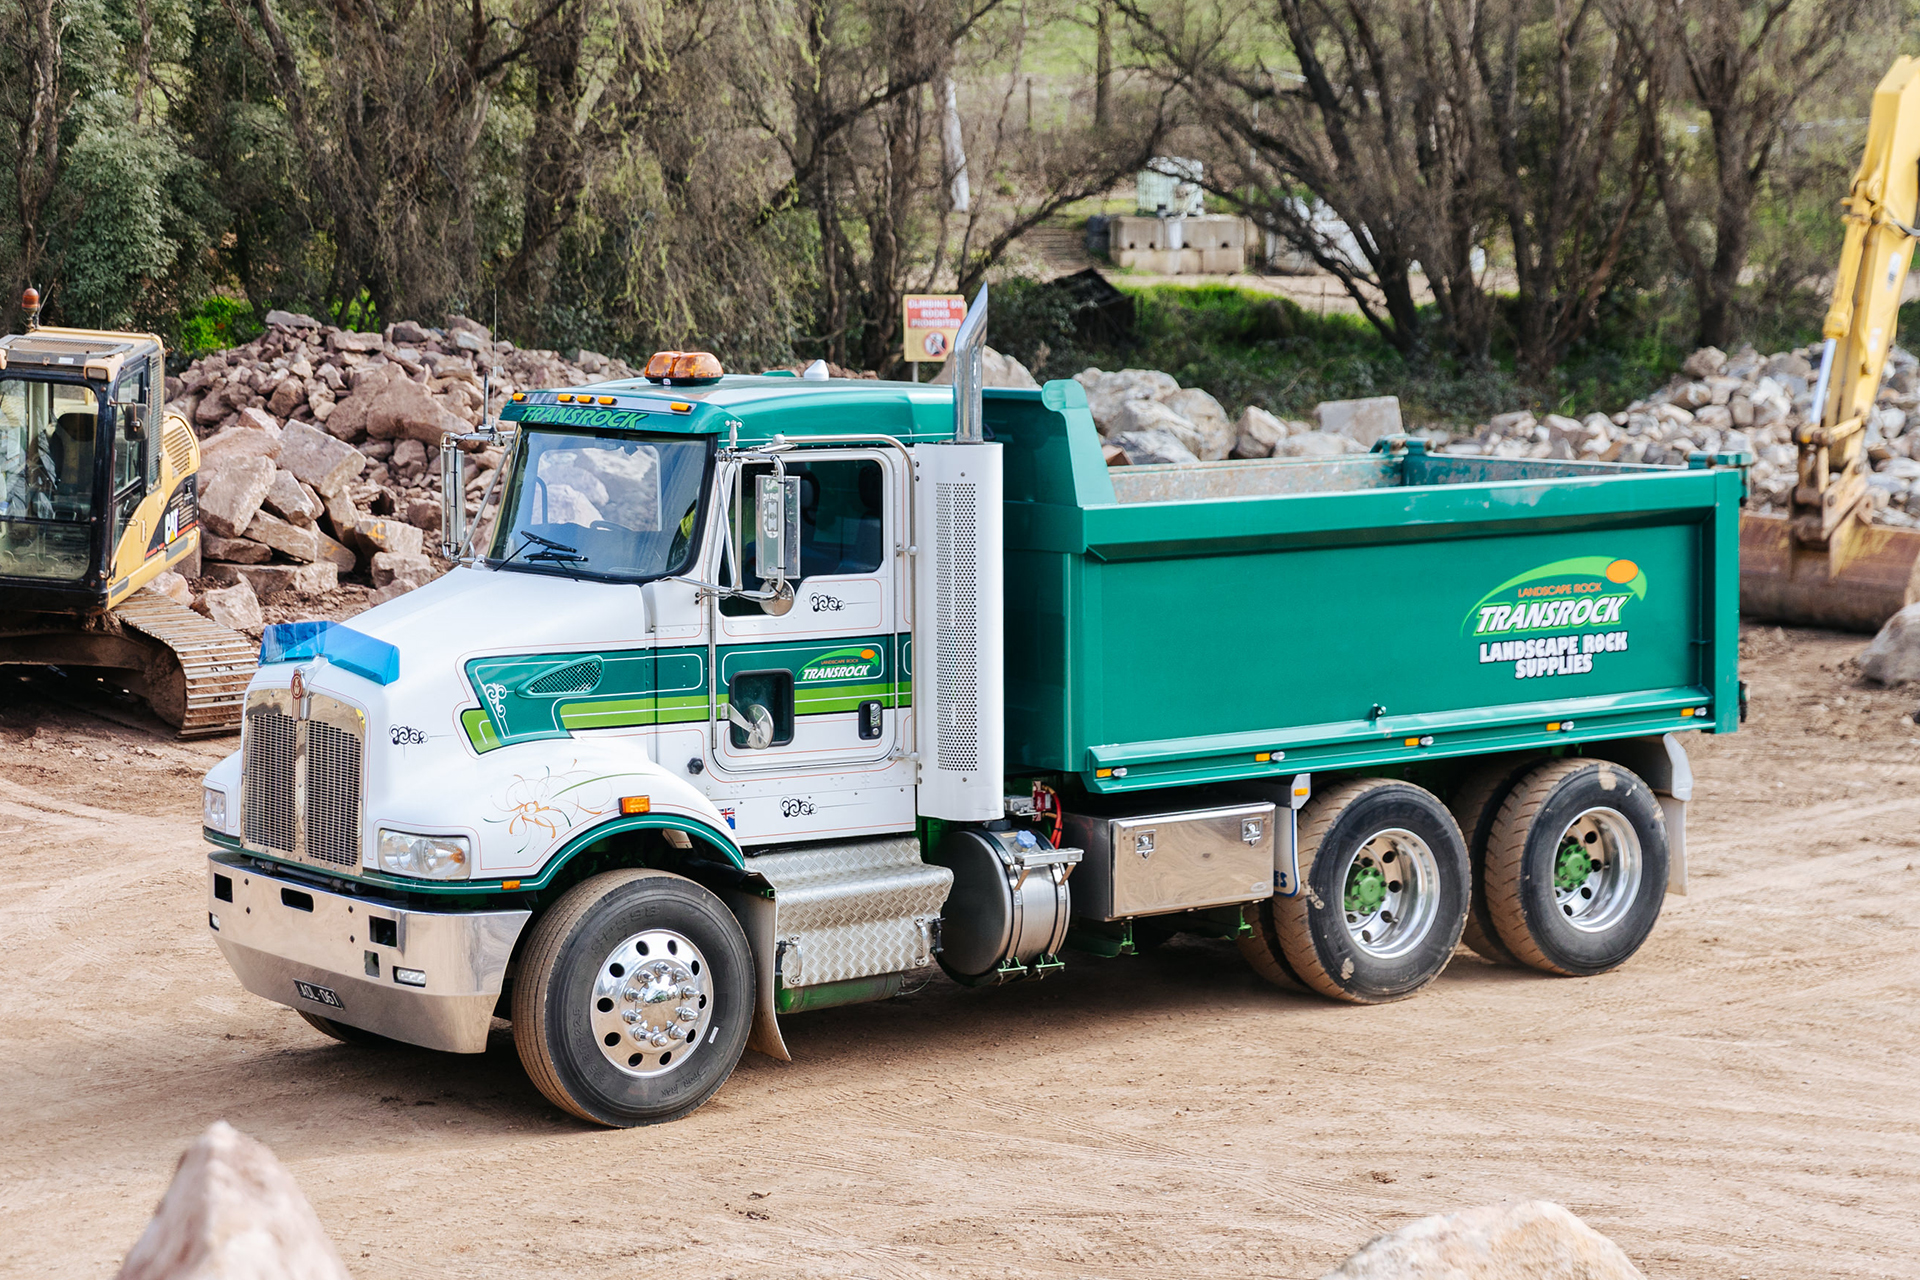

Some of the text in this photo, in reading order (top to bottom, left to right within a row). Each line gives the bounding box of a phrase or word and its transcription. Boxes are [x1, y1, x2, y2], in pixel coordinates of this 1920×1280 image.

[908, 299, 949, 309] CLIMBING
[910, 319, 961, 328] PROHIBITED
[521, 406, 647, 429] TRANSROCK
[165, 508, 179, 545] CAT
[1518, 582, 1603, 598] LANDSCAPE ROCK
[1475, 595, 1629, 634] TRANSROCK
[1479, 631, 1628, 663] LANDSCAPE ROCK
[802, 664, 871, 680] TRANSROCK
[1515, 654, 1593, 679] SUPPLIES
